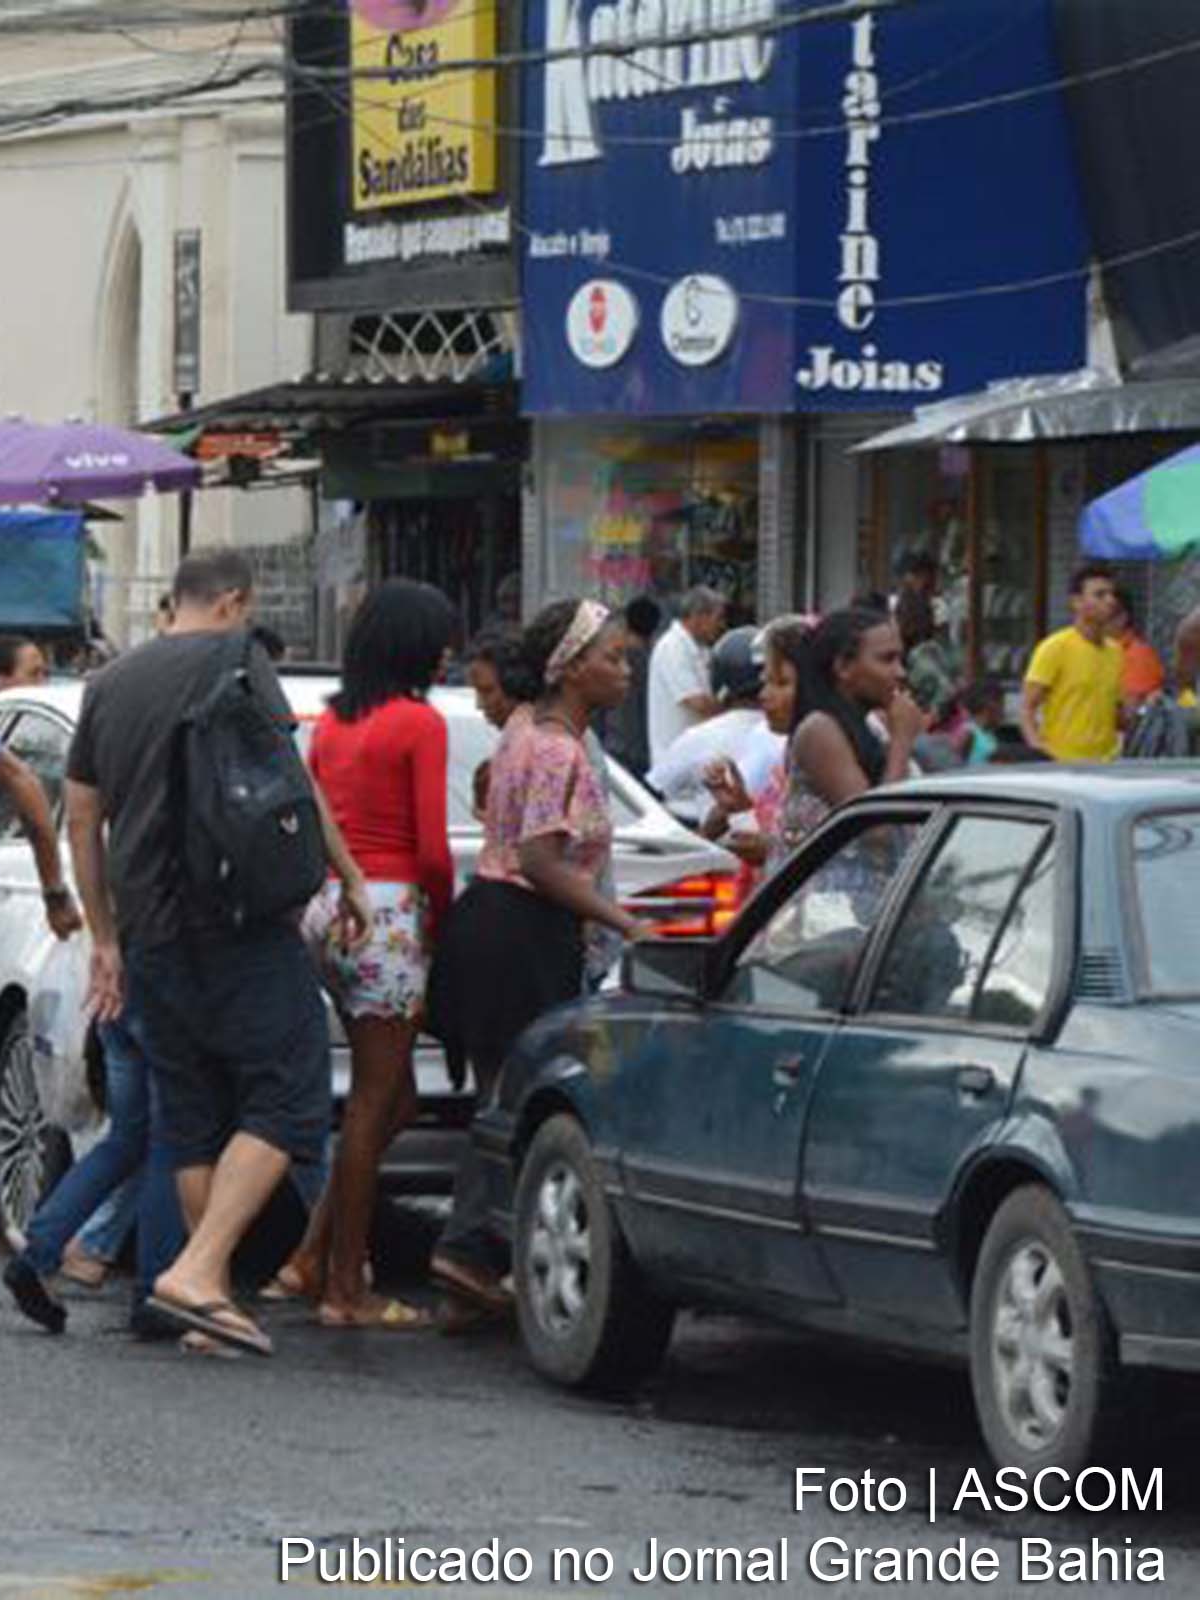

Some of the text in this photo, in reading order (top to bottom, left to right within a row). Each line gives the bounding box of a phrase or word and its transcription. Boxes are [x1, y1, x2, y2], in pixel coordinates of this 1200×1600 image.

[386, 33, 440, 85] Casa
[671, 95, 772, 174] Joias
[358, 137, 469, 198] Sandálias
[796, 343, 943, 392] Joias
